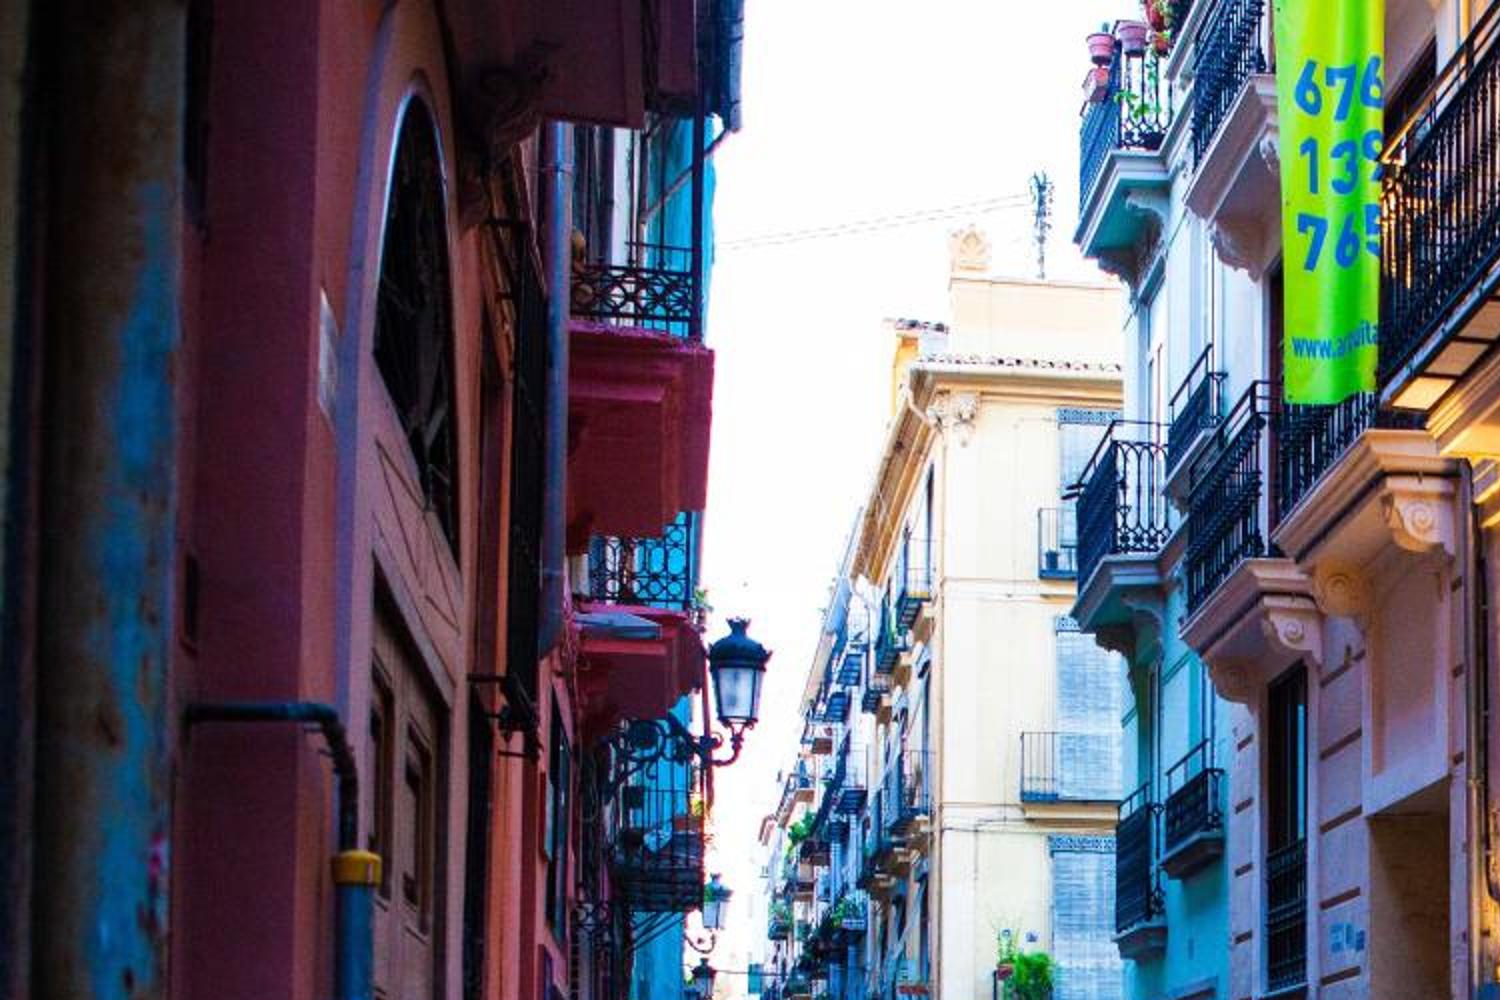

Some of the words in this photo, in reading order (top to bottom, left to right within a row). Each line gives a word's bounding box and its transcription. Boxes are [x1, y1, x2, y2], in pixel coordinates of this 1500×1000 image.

[1295, 55, 1385, 122] 676
[1299, 129, 1384, 194] 139
[1297, 203, 1381, 272] 765
